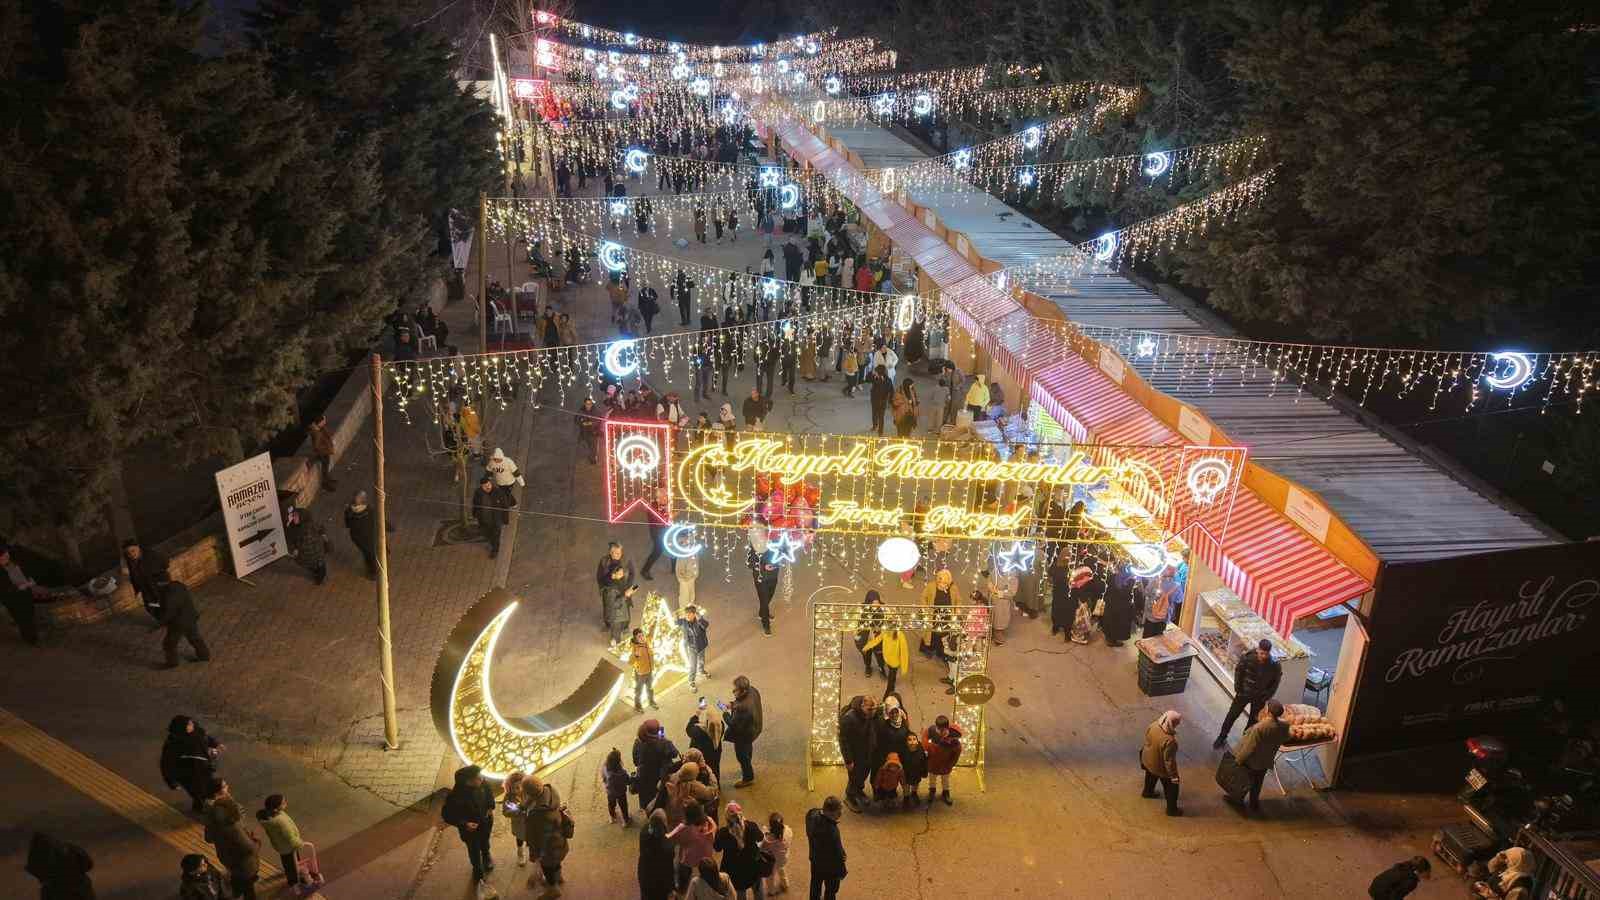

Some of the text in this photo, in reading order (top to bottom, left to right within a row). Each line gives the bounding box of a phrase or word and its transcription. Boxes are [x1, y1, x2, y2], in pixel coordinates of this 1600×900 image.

[875, 442, 1115, 485] Ramazanlar
[227, 479, 271, 508] RAMAZAN
[1385, 579, 1600, 683] Ramazanlar
[1438, 575, 1556, 645] Hayırlı
